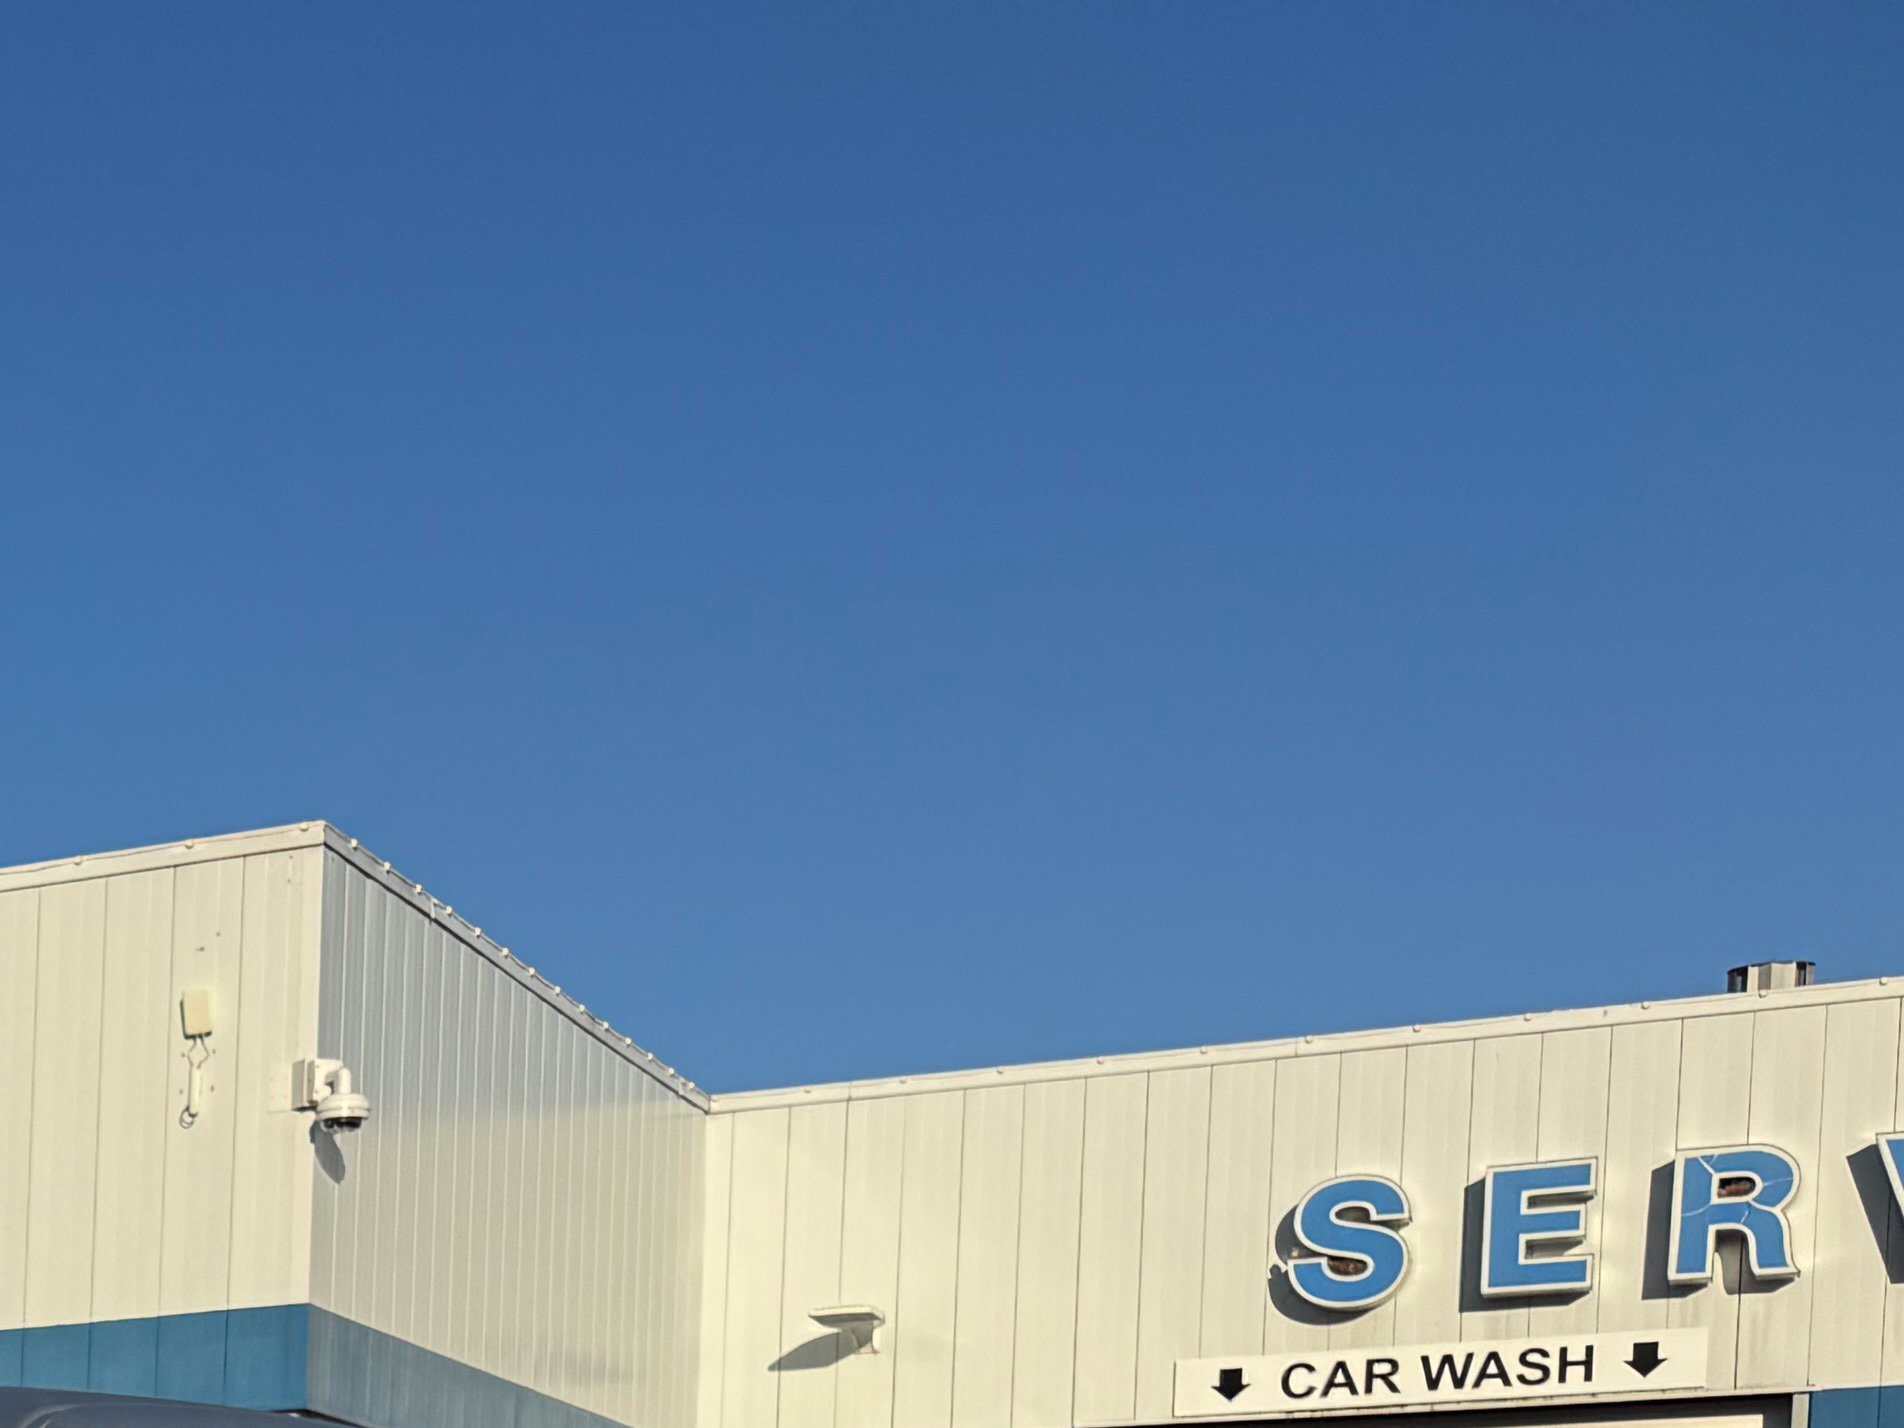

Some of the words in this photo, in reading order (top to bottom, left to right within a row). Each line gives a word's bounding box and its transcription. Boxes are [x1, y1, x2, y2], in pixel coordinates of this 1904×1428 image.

[1288, 1133, 1904, 1310] SER
[1280, 1358, 1401, 1399] CAR
[1421, 1344, 1594, 1392] WASH
